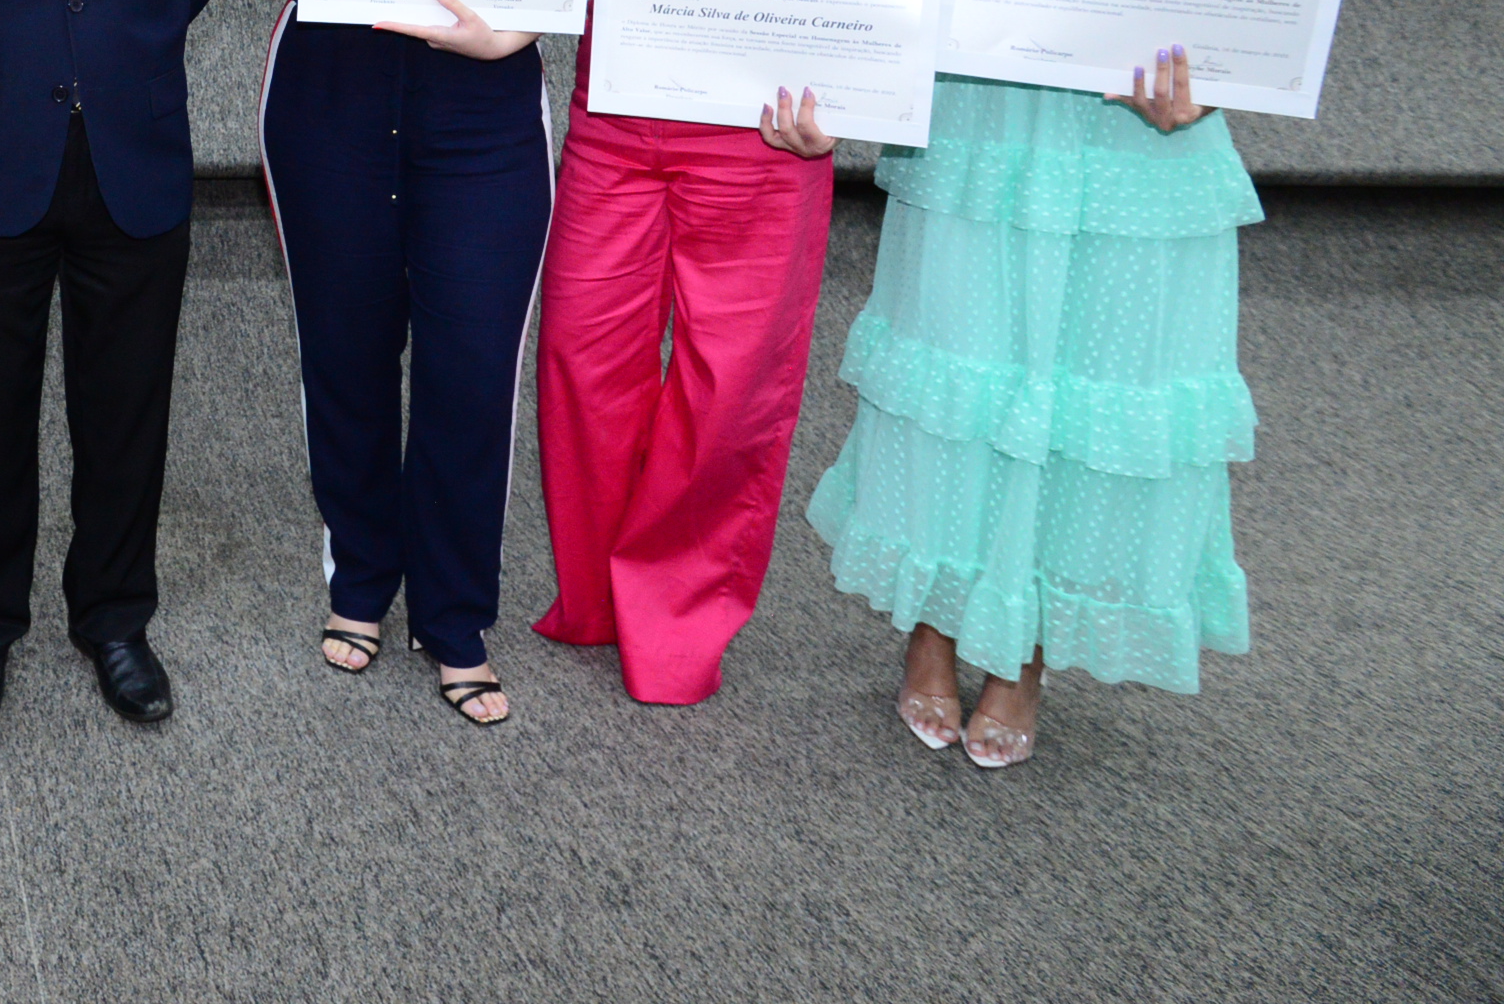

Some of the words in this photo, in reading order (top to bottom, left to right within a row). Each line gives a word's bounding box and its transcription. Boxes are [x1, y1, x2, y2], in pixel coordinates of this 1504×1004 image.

[652, 3, 695, 17] Márcia
[697, 7, 731, 19] Silva
[734, 10, 750, 21] de
[753, 12, 807, 26] Oliveira
[811, 17, 873, 31] Carneiro
